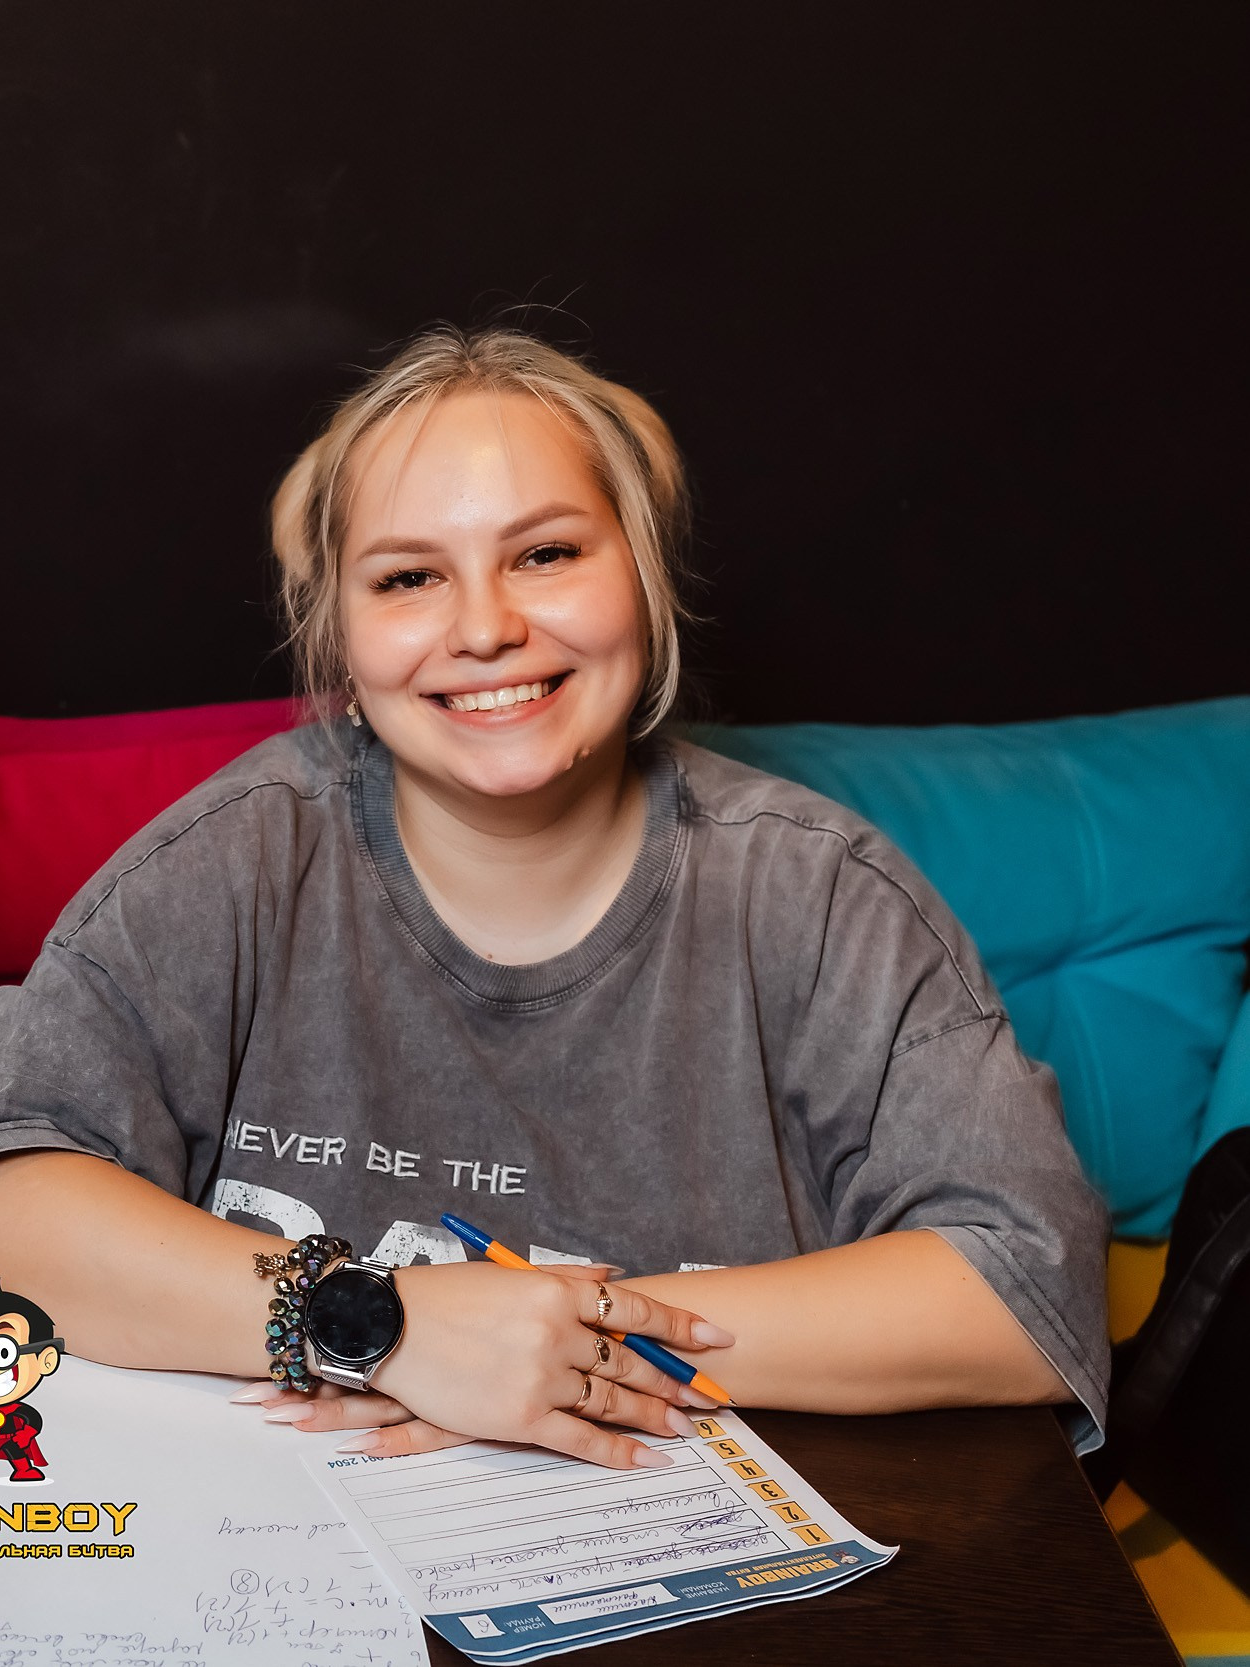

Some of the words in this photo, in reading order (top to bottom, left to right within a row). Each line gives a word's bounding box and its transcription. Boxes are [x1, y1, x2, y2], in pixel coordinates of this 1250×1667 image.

[224, 1118, 346, 1165] NEVER
[366, 1142, 420, 1178] BE
[443, 1159, 526, 1195] THE
[700, 1422, 713, 1435] 6
[719, 1443, 736, 1455] 5
[327, 1457, 358, 1469] 2504
[740, 1463, 757, 1475] 4
[760, 1483, 778, 1498] 3
[782, 1506, 800, 1520] 2
[806, 1528, 821, 1542] 1
[735, 1558, 840, 1589] BRAINBOY
[477, 1619, 490, 1633] 6
[513, 1621, 546, 1634] НОМЕР
